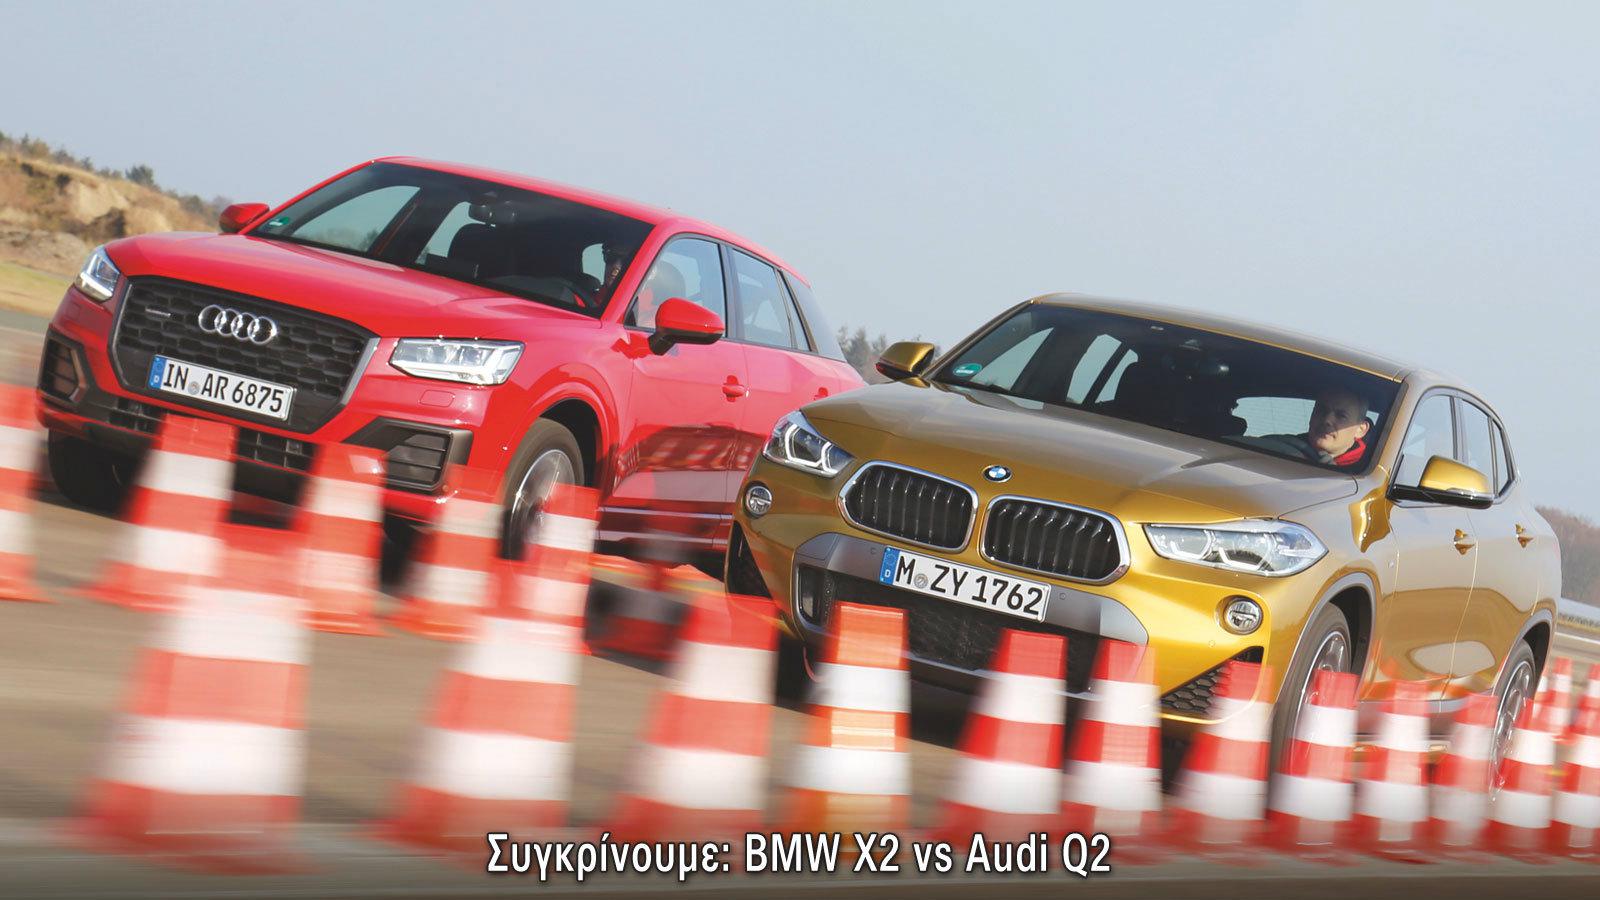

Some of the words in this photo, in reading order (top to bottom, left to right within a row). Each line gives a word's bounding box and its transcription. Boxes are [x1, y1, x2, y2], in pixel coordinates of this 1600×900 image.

[163, 363, 189, 391] IN
[201, 373, 229, 400] AR
[232, 381, 284, 413] 6875
[895, 555, 916, 585] M
[930, 564, 969, 597] ZY
[971, 575, 1043, 616] 1762
